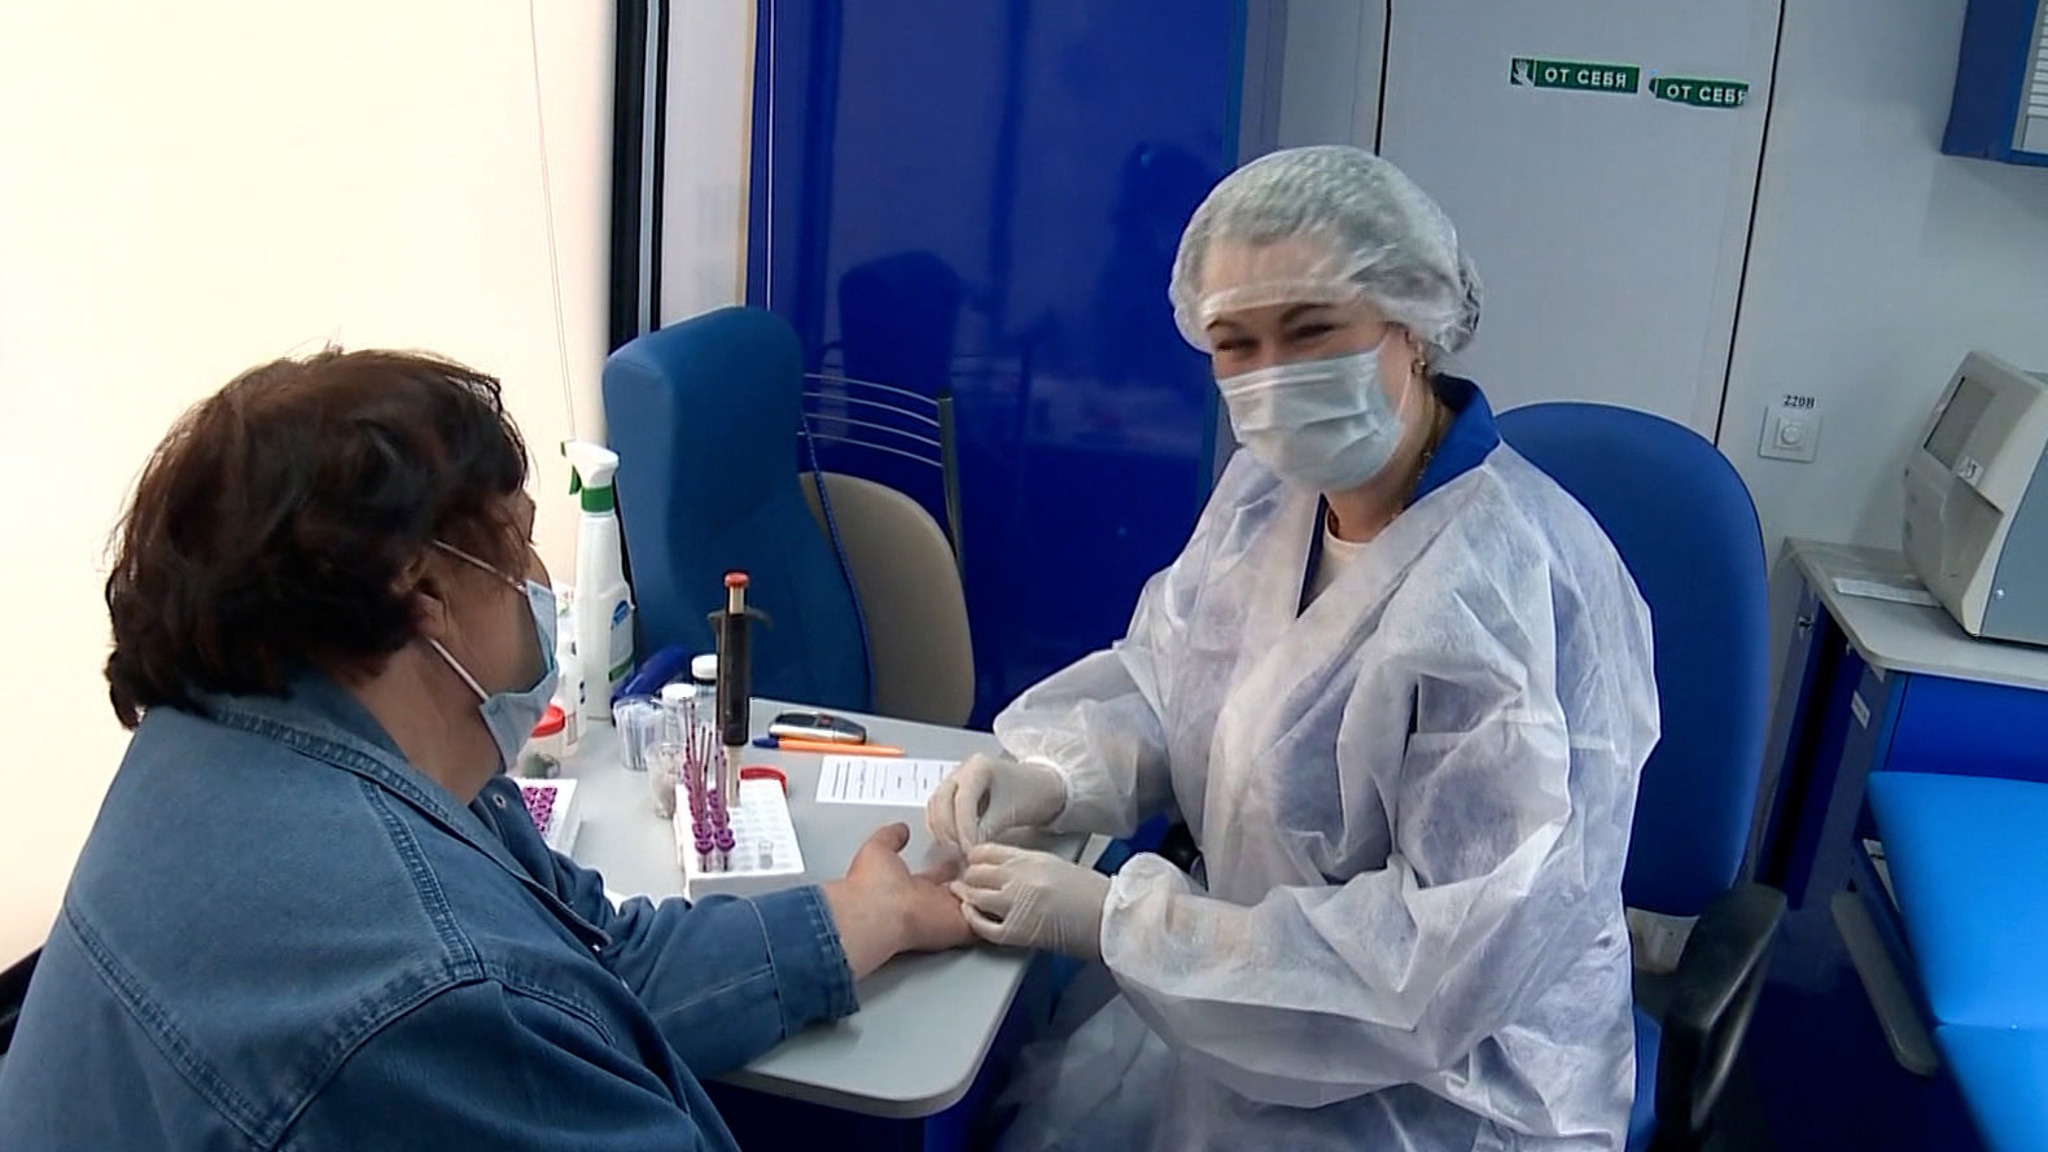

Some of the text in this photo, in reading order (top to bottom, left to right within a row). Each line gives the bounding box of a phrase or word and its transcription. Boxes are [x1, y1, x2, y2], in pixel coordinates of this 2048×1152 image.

[1544, 68, 1627, 88] ОТ СЕБЯ
[1666, 83, 1692, 99] ОТ
